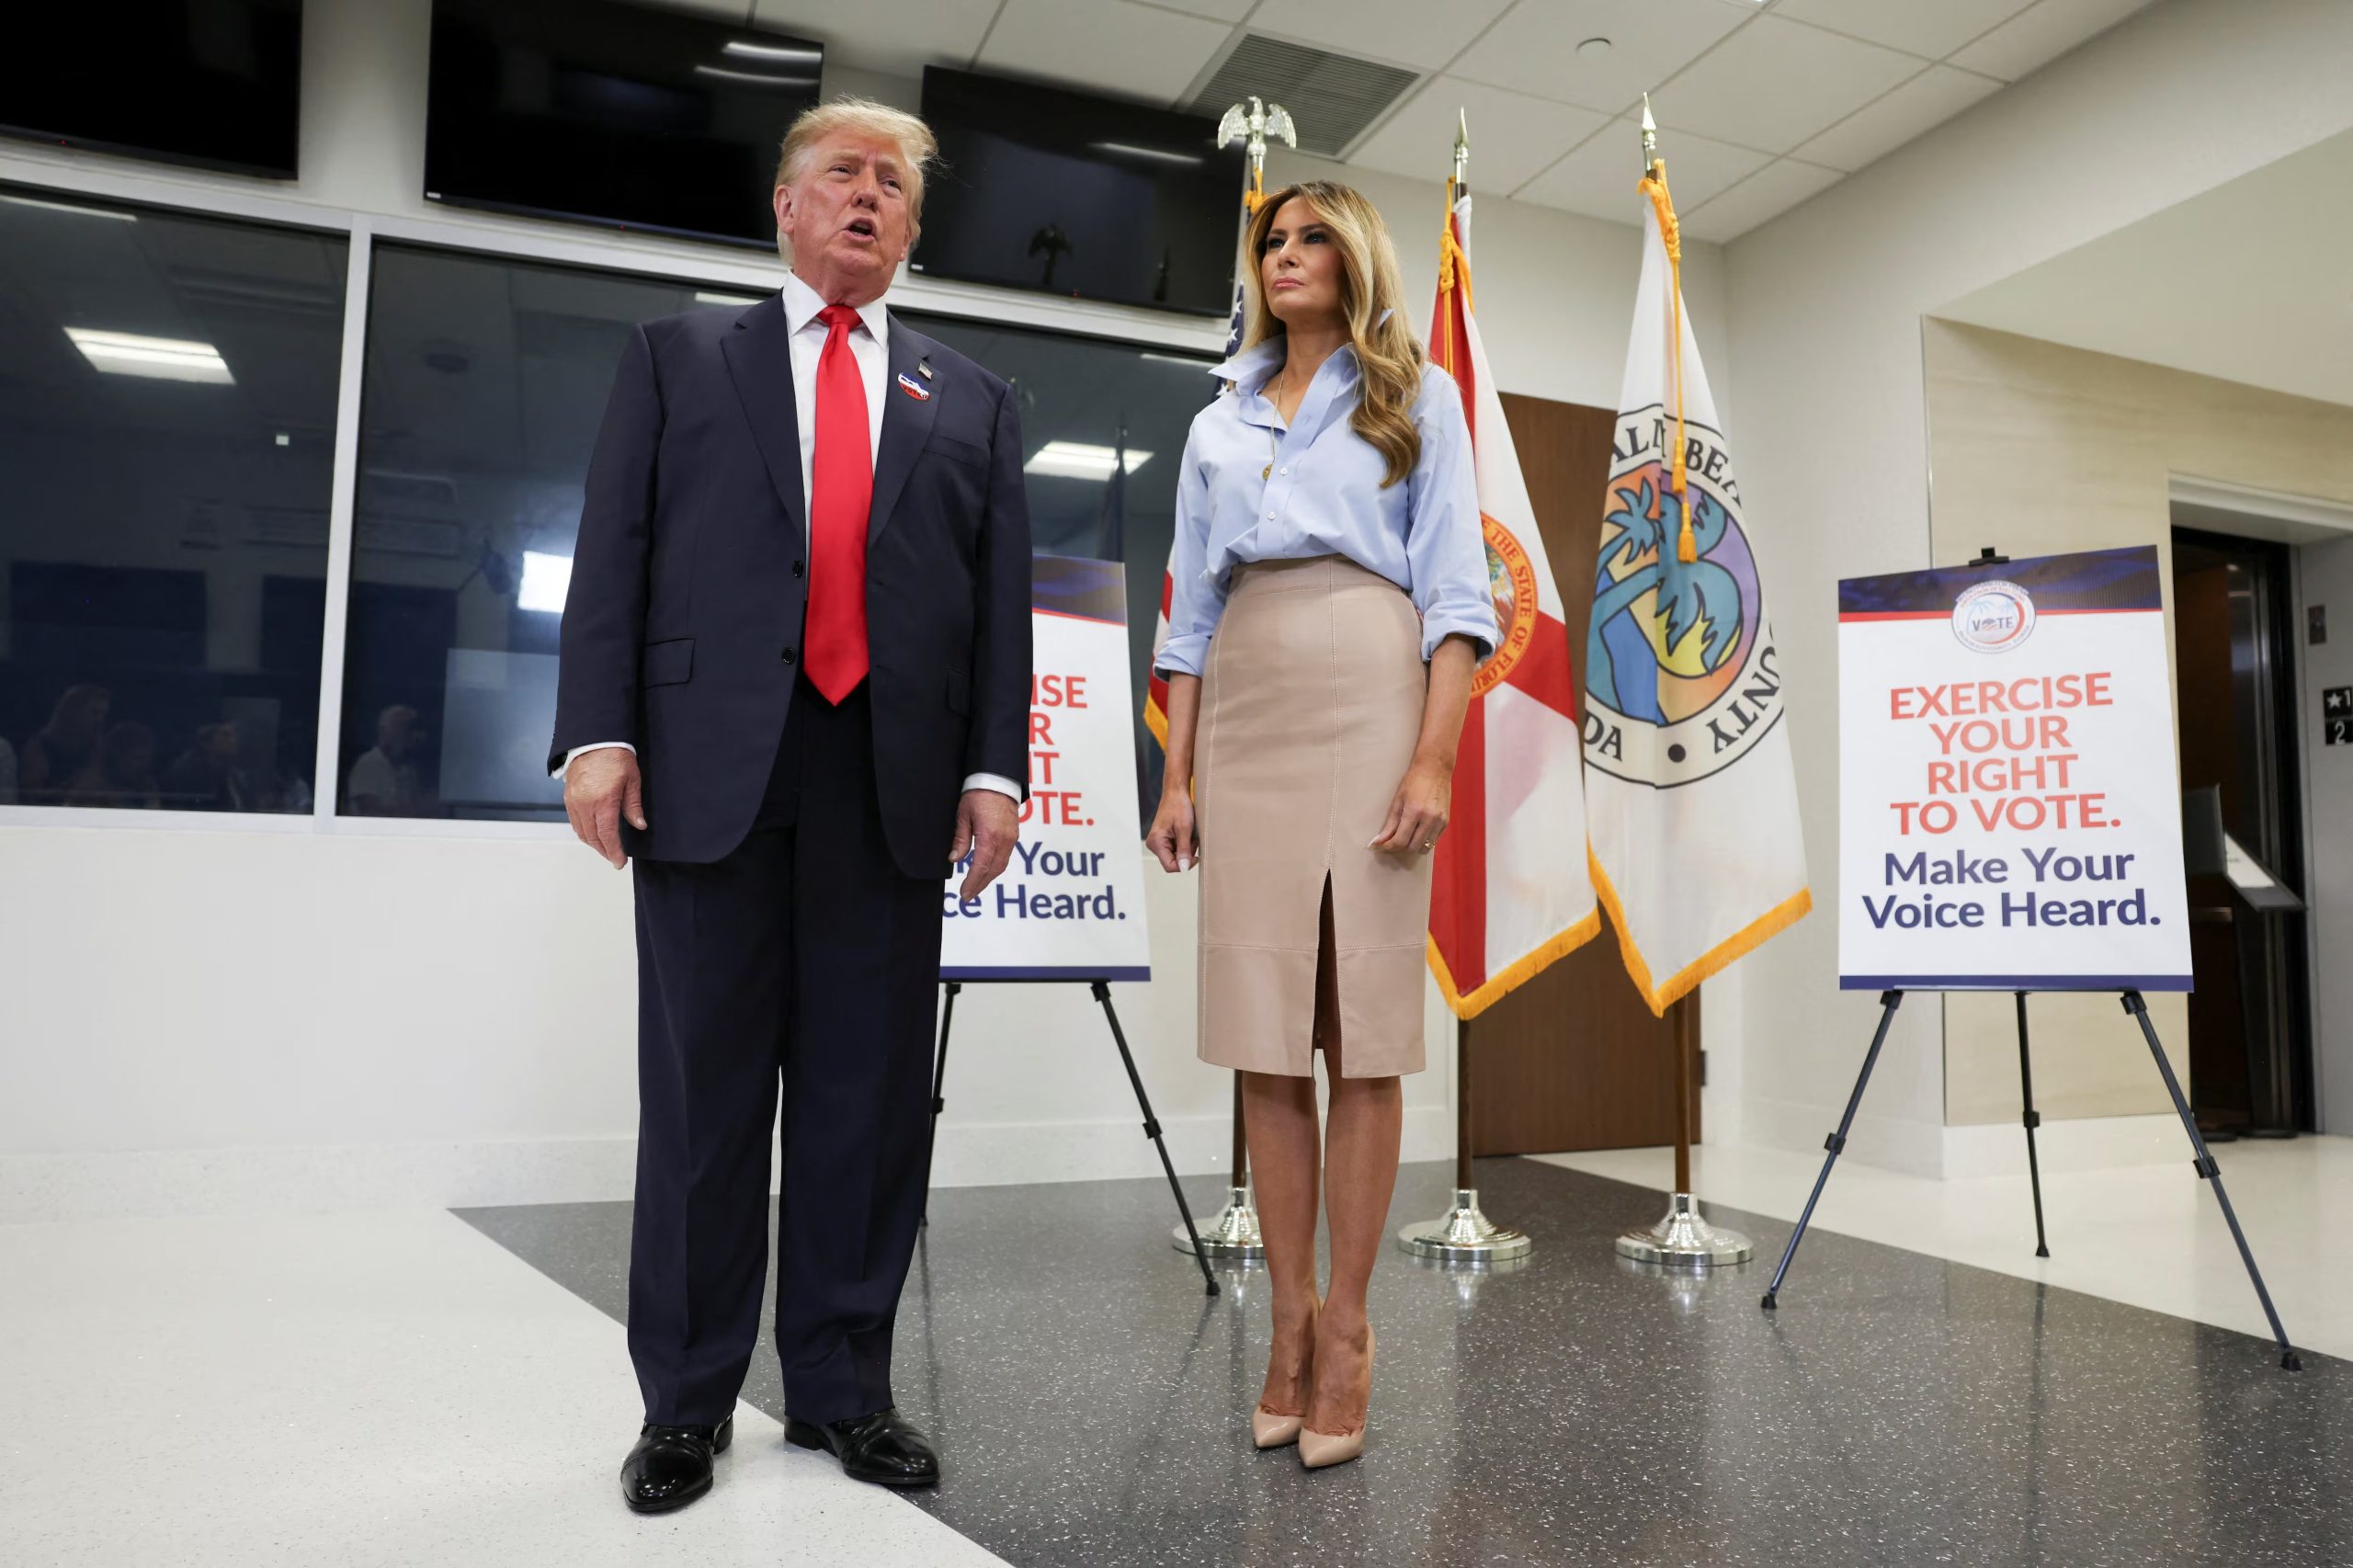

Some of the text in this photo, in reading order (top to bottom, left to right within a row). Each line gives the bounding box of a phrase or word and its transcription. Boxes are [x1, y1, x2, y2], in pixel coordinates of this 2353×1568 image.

[1685, 437, 1743, 509] BEA
[1471, 528, 1533, 692] THE STATE OF FLORI
[1706, 643, 1781, 756] UNTY
[1890, 671, 2114, 721] EXERCISE
[1928, 715, 2072, 756] YOUR
[2335, 720, 2347, 745] 2
[1927, 754, 2079, 795] RIGHT
[1017, 790, 1096, 827] TE.
[1889, 792, 2122, 835] TO VOTE.
[1014, 841, 1106, 877] Your
[1884, 846, 2135, 886] Make Your
[995, 882, 1127, 920] Heard.
[1860, 888, 2162, 929] Voice Heard.
